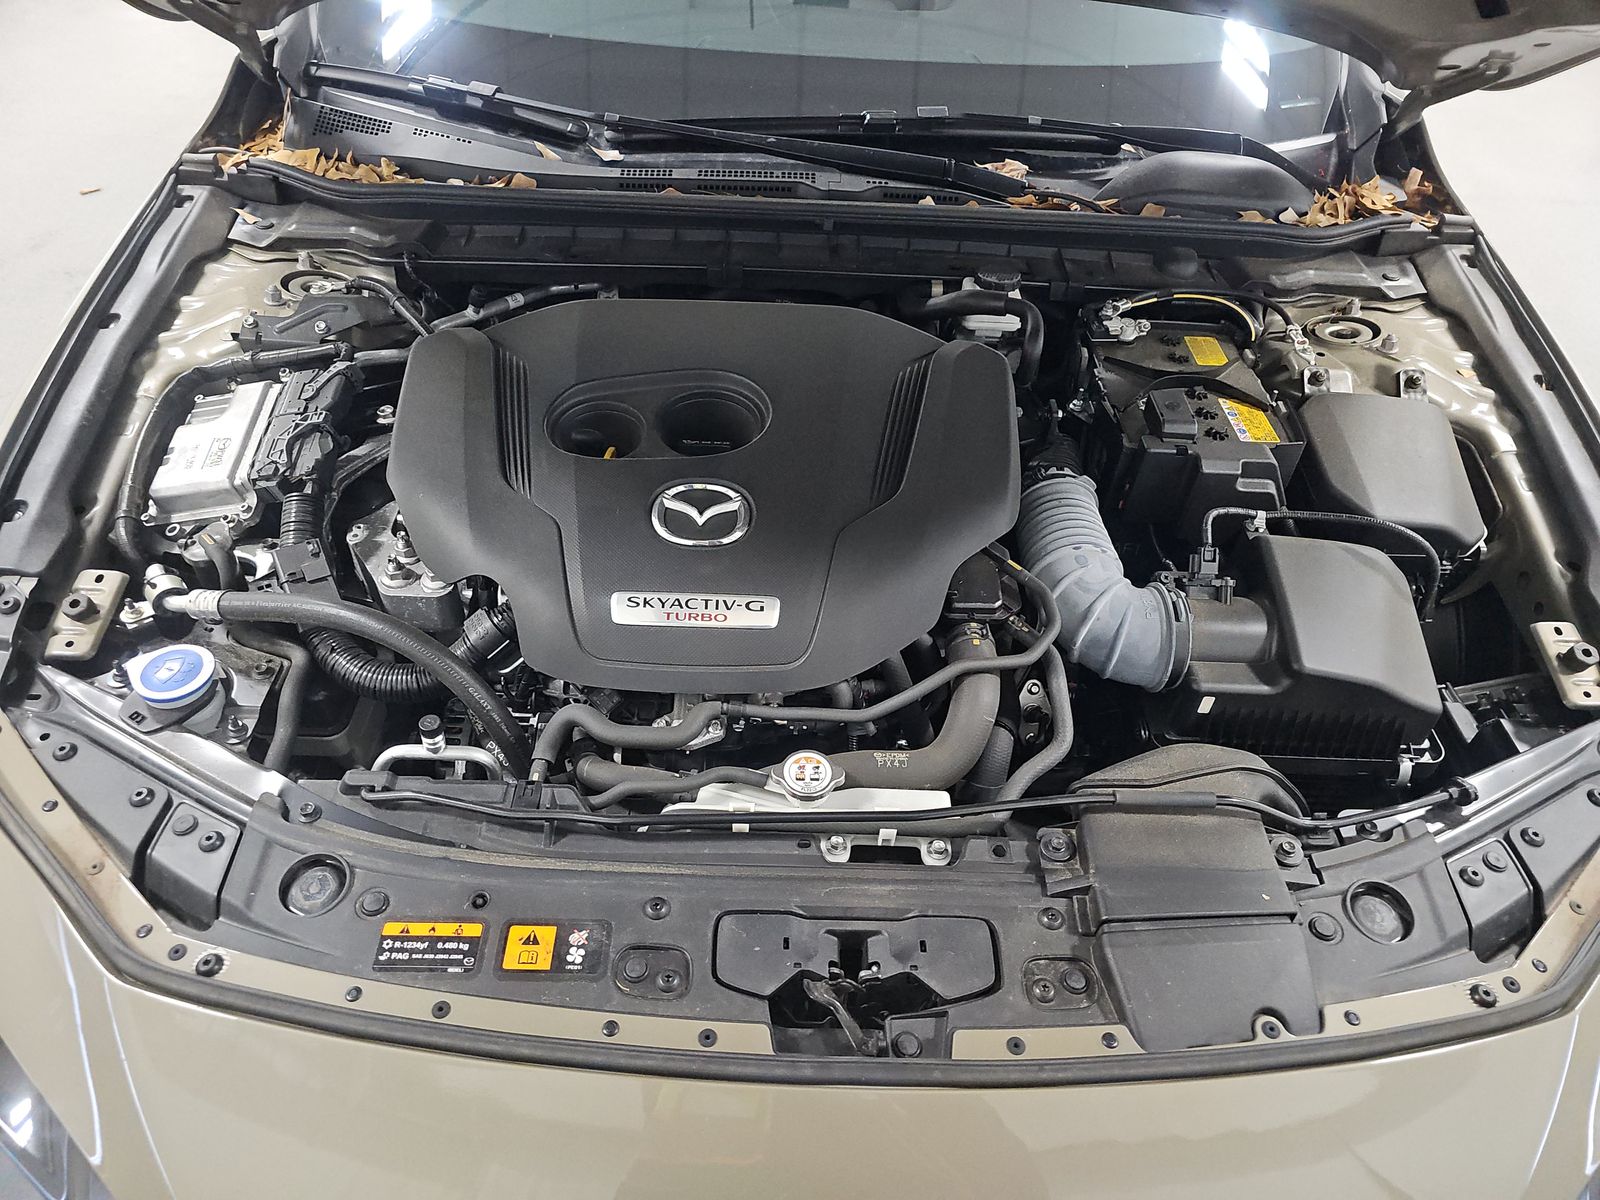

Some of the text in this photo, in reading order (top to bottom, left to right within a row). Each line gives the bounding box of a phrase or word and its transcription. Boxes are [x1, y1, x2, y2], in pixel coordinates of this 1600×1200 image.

[626, 596, 765, 612] SKYACTIV-G
[663, 612, 728, 623] TURBO
[877, 759, 908, 768] PX4J
[393, 941, 430, 950] R-1234yf
[459, 942, 470, 951] kg
[391, 952, 410, 960] PAG
